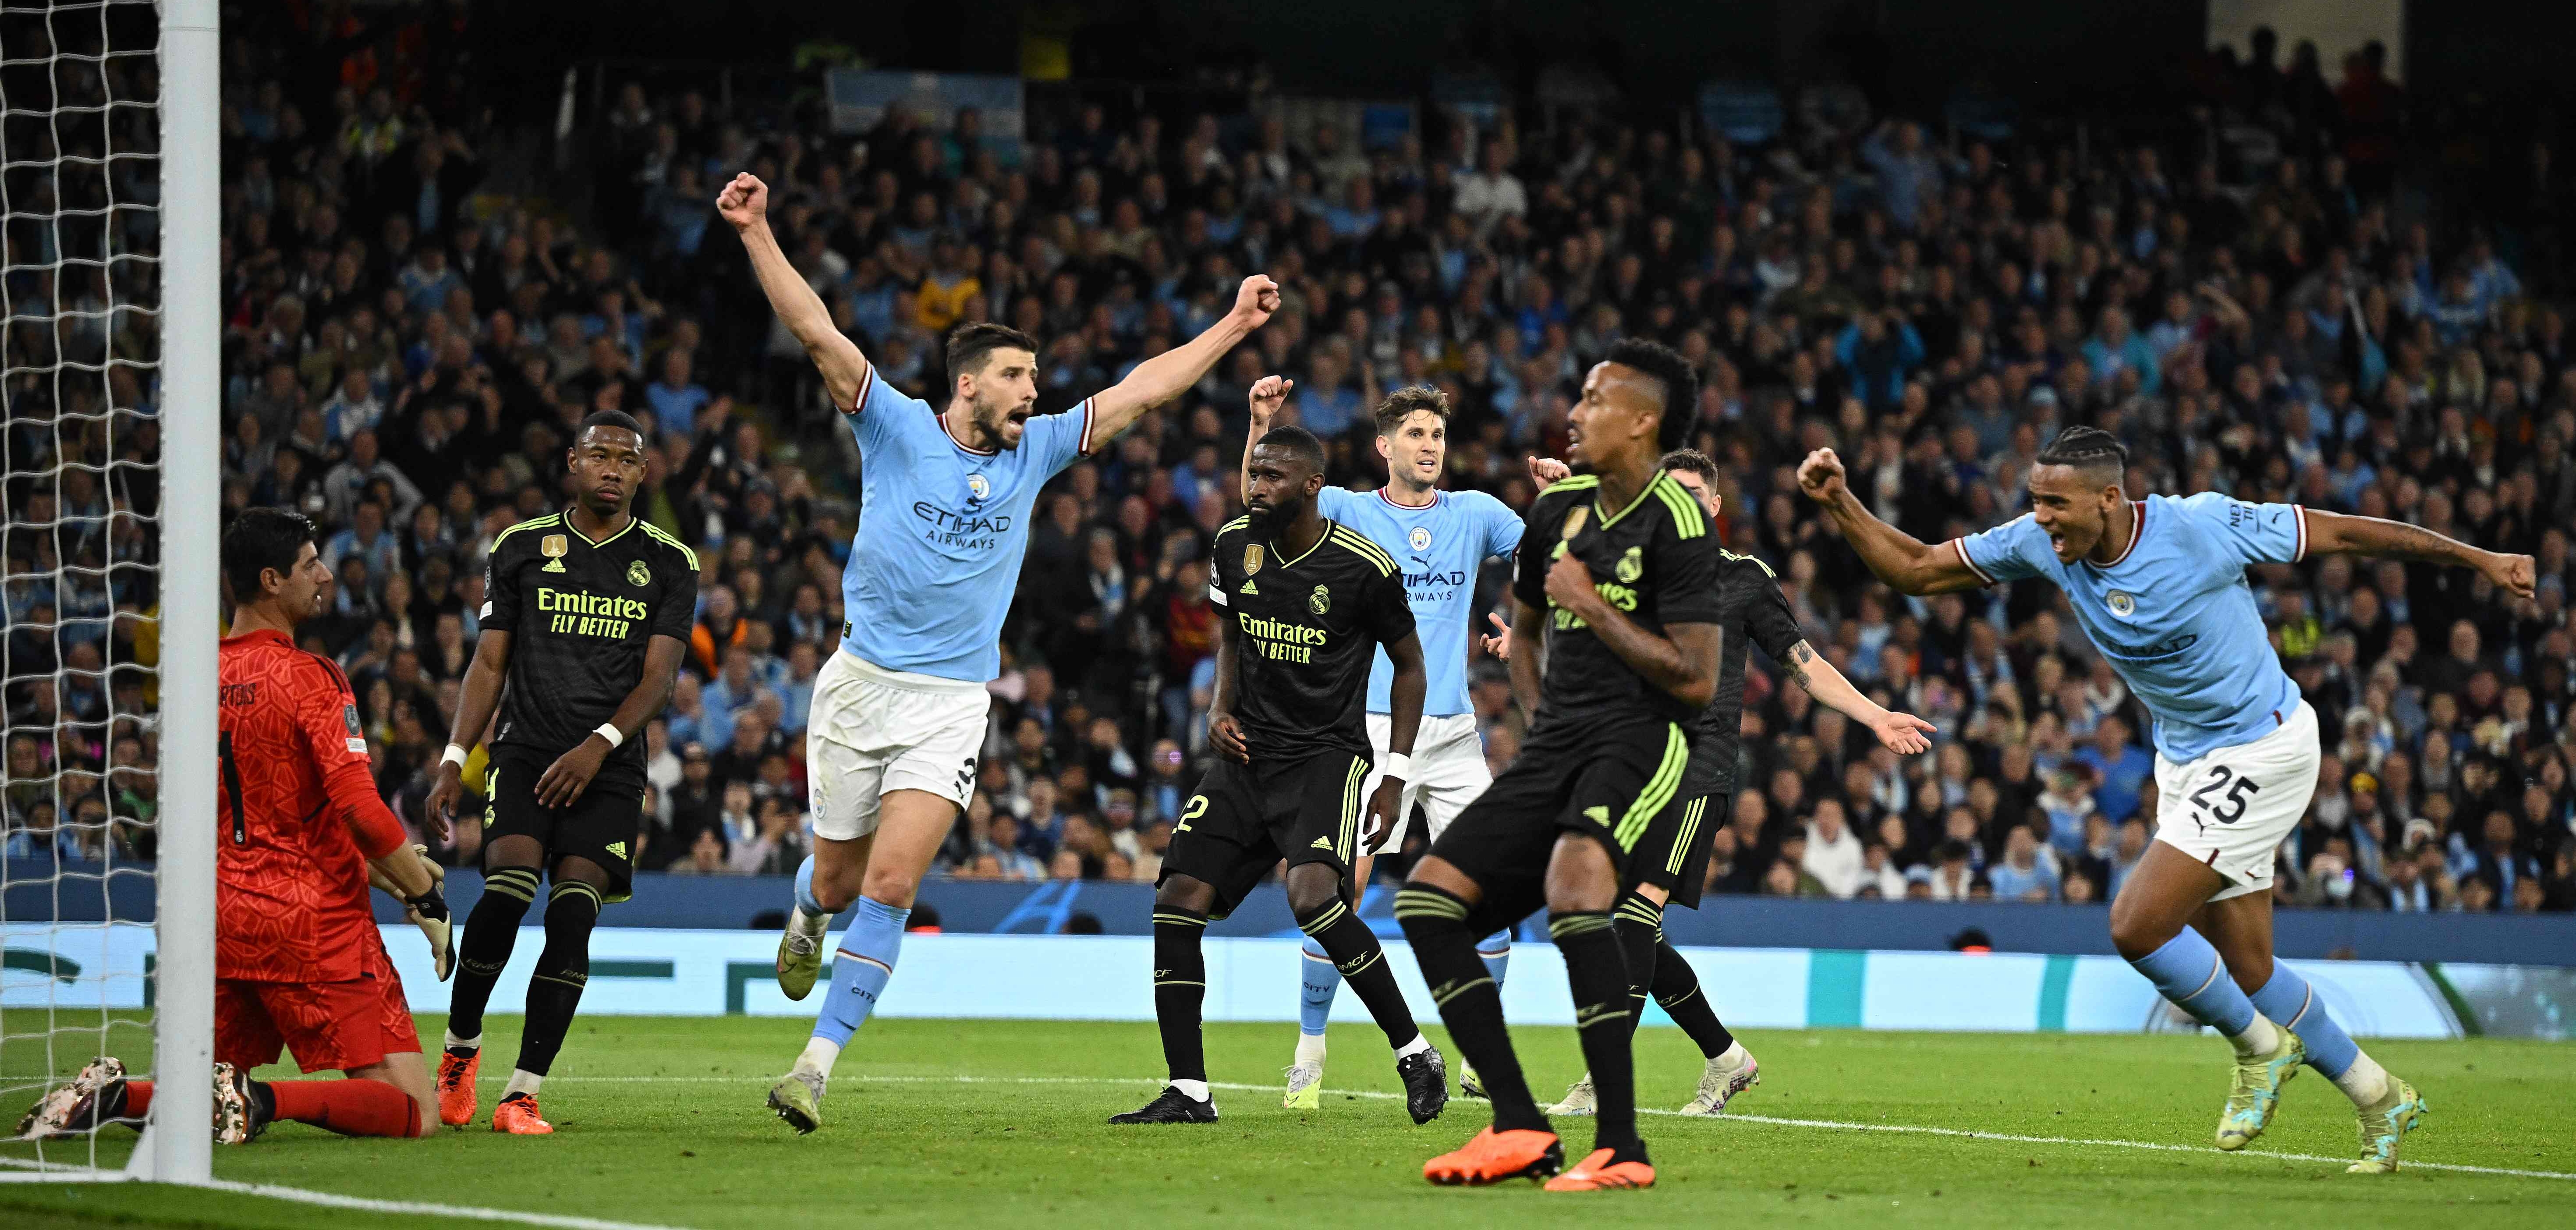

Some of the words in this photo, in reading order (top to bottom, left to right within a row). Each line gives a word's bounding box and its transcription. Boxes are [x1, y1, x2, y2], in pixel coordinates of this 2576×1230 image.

[913, 501, 1011, 533] ETIHAD
[926, 530, 995, 549] AIRWAYS
[1402, 571, 1465, 587] IHAD
[537, 588, 647, 620] Emirates
[551, 614, 577, 634] FLY
[578, 616, 630, 639] BETTER
[1238, 612, 1326, 645] Emirates
[1269, 642, 1311, 664] BETTER
[958, 757, 975, 785] 3
[219, 730, 244, 845] 1
[2189, 765, 2261, 824] 25
[605, 845, 627, 860] adidas
[851, 987, 876, 1004] CITY
[1304, 981, 1330, 993] CITY
